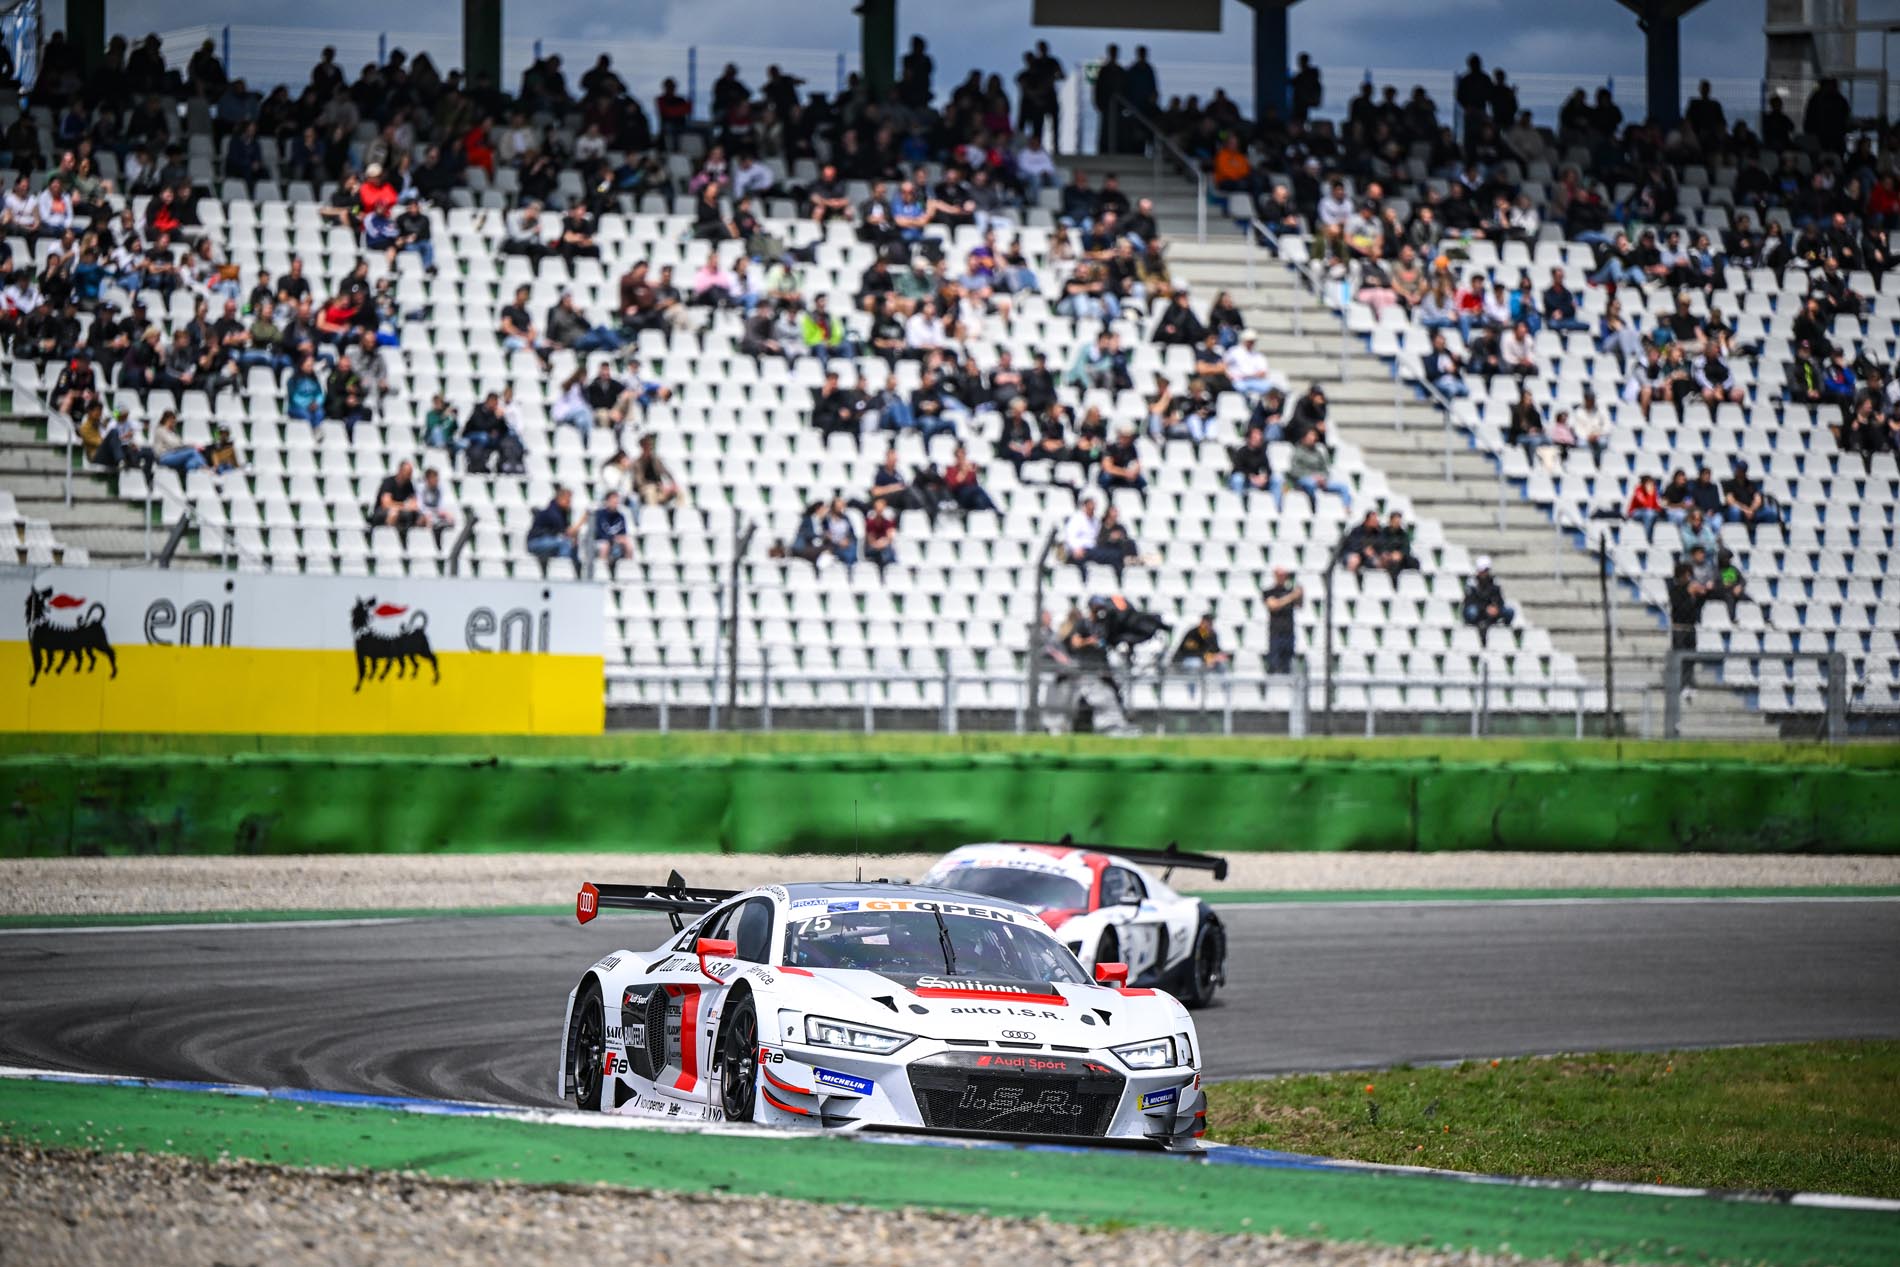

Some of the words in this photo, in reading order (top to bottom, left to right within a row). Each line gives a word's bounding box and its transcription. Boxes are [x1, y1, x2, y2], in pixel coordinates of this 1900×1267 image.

[144, 579, 233, 647] eni
[465, 589, 551, 654] eni
[792, 899, 828, 909] PROAM
[797, 915, 832, 935] 75
[951, 1007, 1001, 1015] auto
[1007, 1008, 1065, 1021] I.S.R.
[763, 1052, 784, 1064] R8
[994, 1056, 1025, 1067] Audi
[1029, 1058, 1067, 1071] Sport
[610, 1058, 628, 1074] R8
[822, 1074, 866, 1089] MICHELIN
